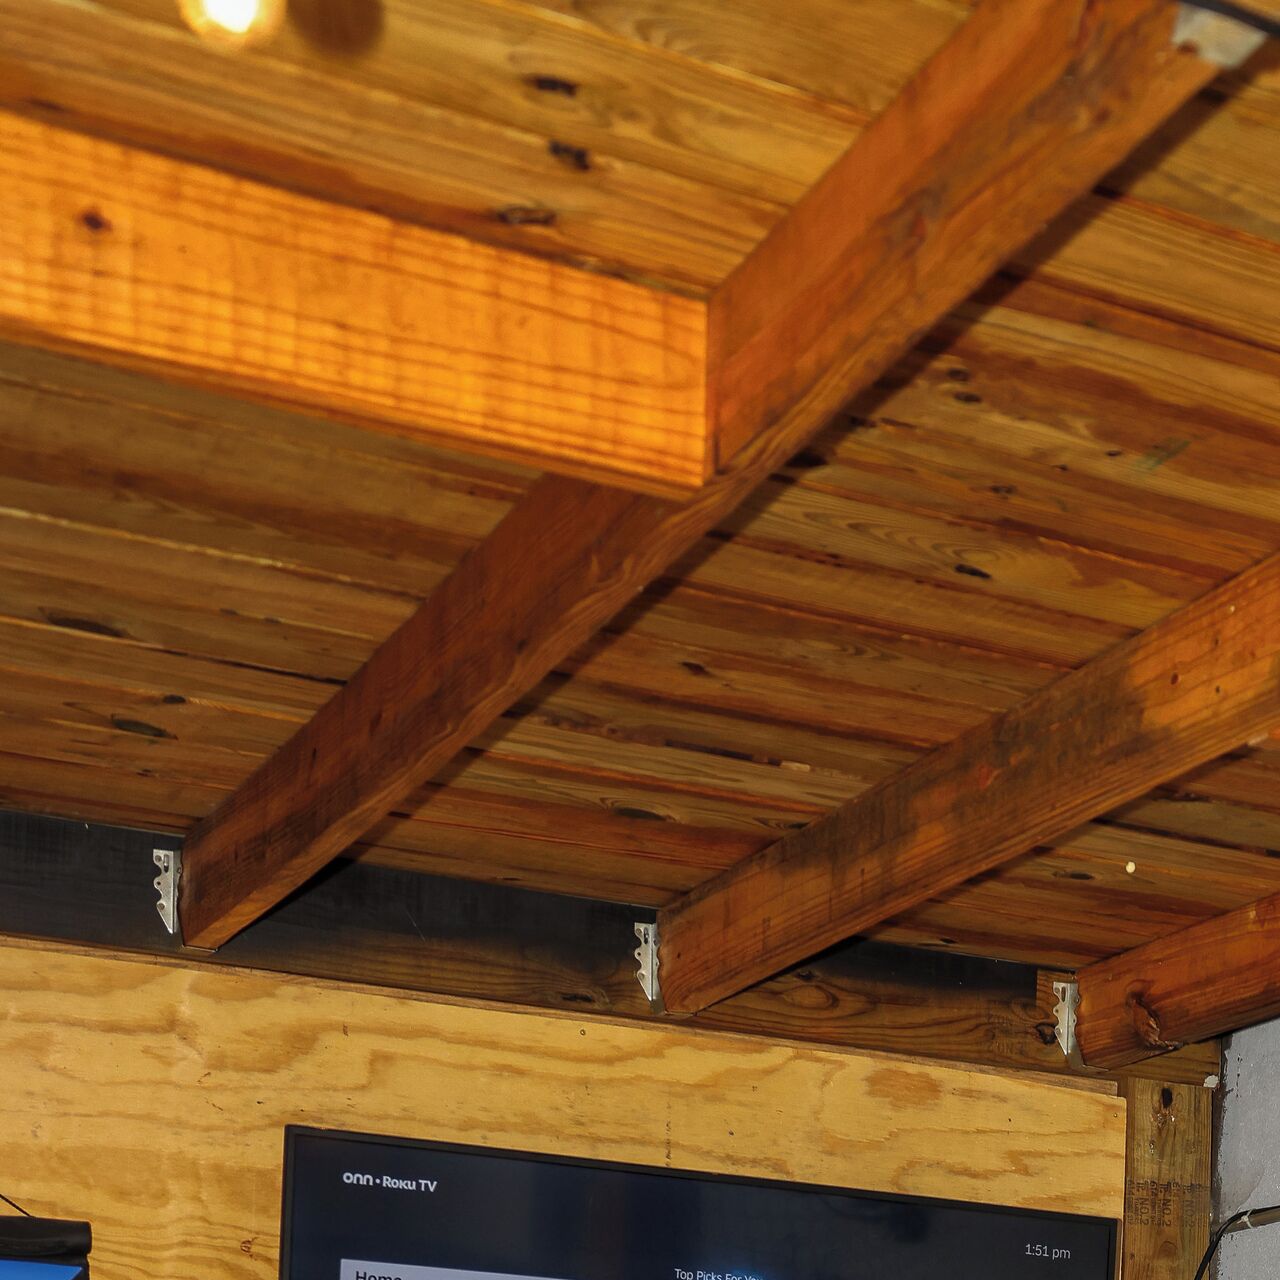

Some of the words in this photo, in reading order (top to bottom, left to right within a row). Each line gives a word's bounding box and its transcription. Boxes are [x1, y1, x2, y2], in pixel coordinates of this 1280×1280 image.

[342, 1172, 374, 1187] onn
[382, 1175, 417, 1191] Roku
[418, 1179, 438, 1193] TV
[1025, 1243, 1050, 1258] 1:51
[1052, 1247, 1071, 1261] pm
